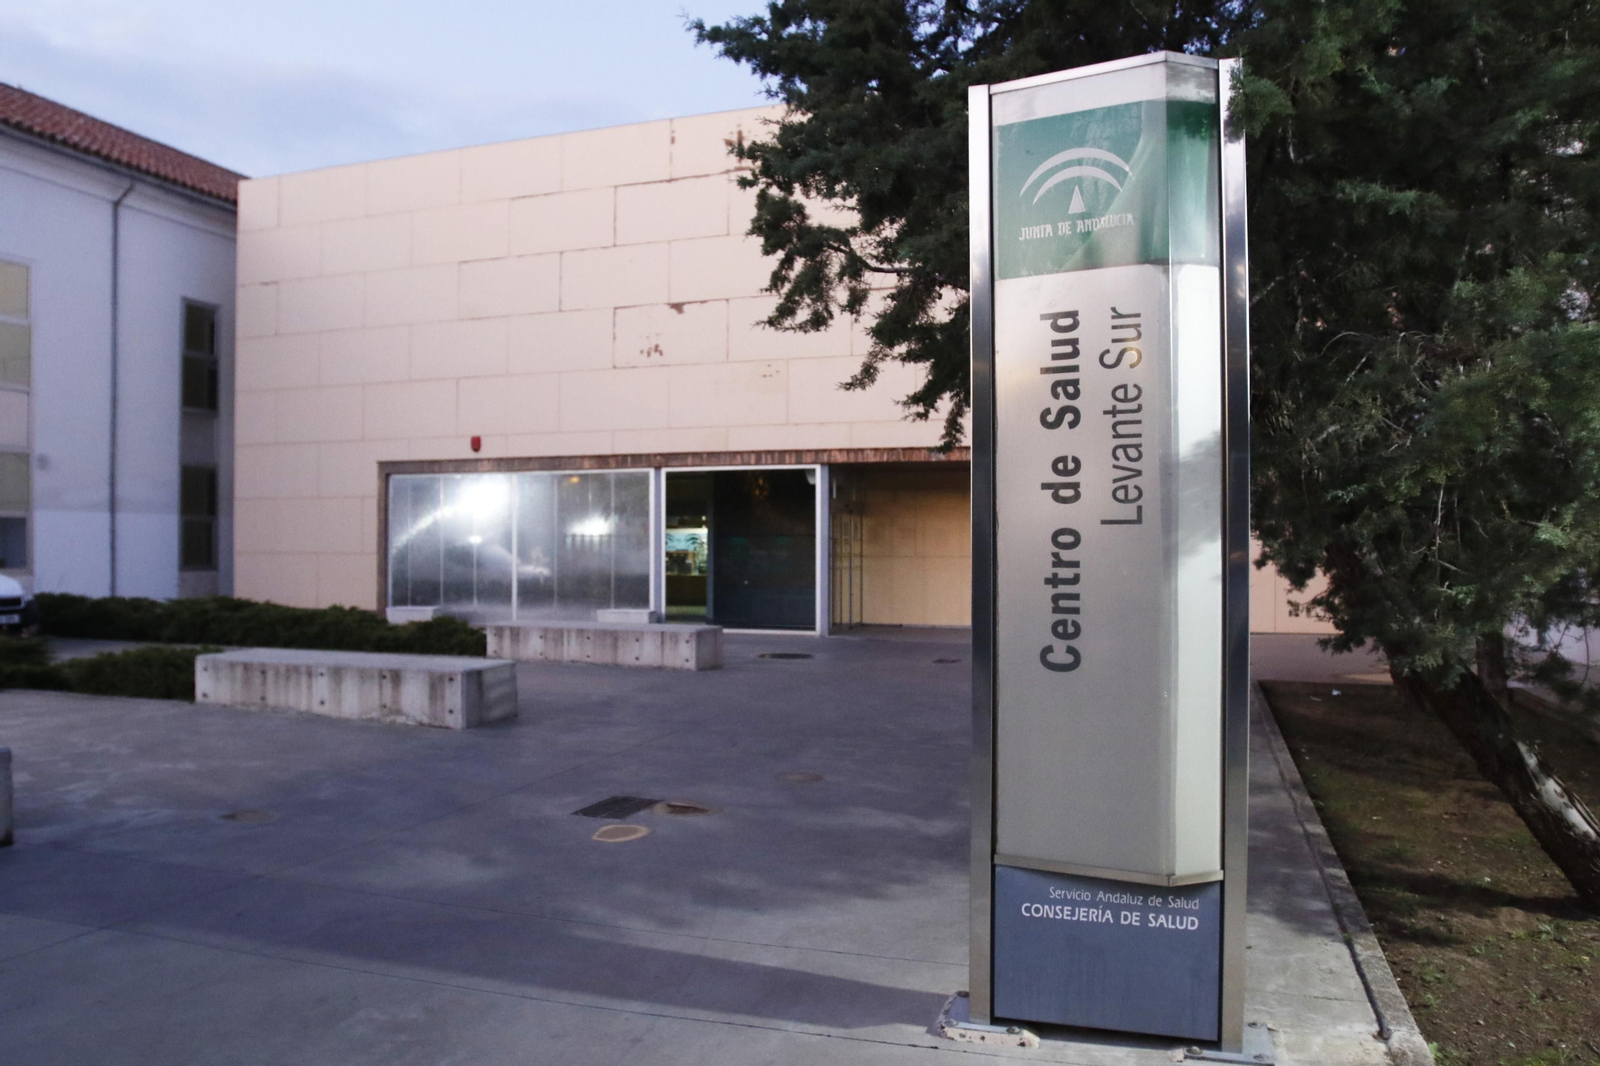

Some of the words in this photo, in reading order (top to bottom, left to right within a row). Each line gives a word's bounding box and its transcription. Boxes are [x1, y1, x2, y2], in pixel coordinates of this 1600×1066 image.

[1018, 223, 1053, 241] JUNTA
[1057, 221, 1072, 235] DE
[1098, 306, 1143, 370] Sur
[1039, 309, 1082, 430] Salud
[1040, 455, 1082, 505] de
[1100, 383, 1143, 526] Levante
[1039, 526, 1082, 673] Centro
[1021, 902, 1114, 924] CONSEJERÍA
[1120, 911, 1141, 926] DE
[1148, 913, 1199, 931] SALUD
[1049, 886, 1092, 902] Servicio
[1096, 890, 1144, 906] Andaluz
[1148, 894, 1163, 908] de
[1168, 895, 1200, 910] Salud
